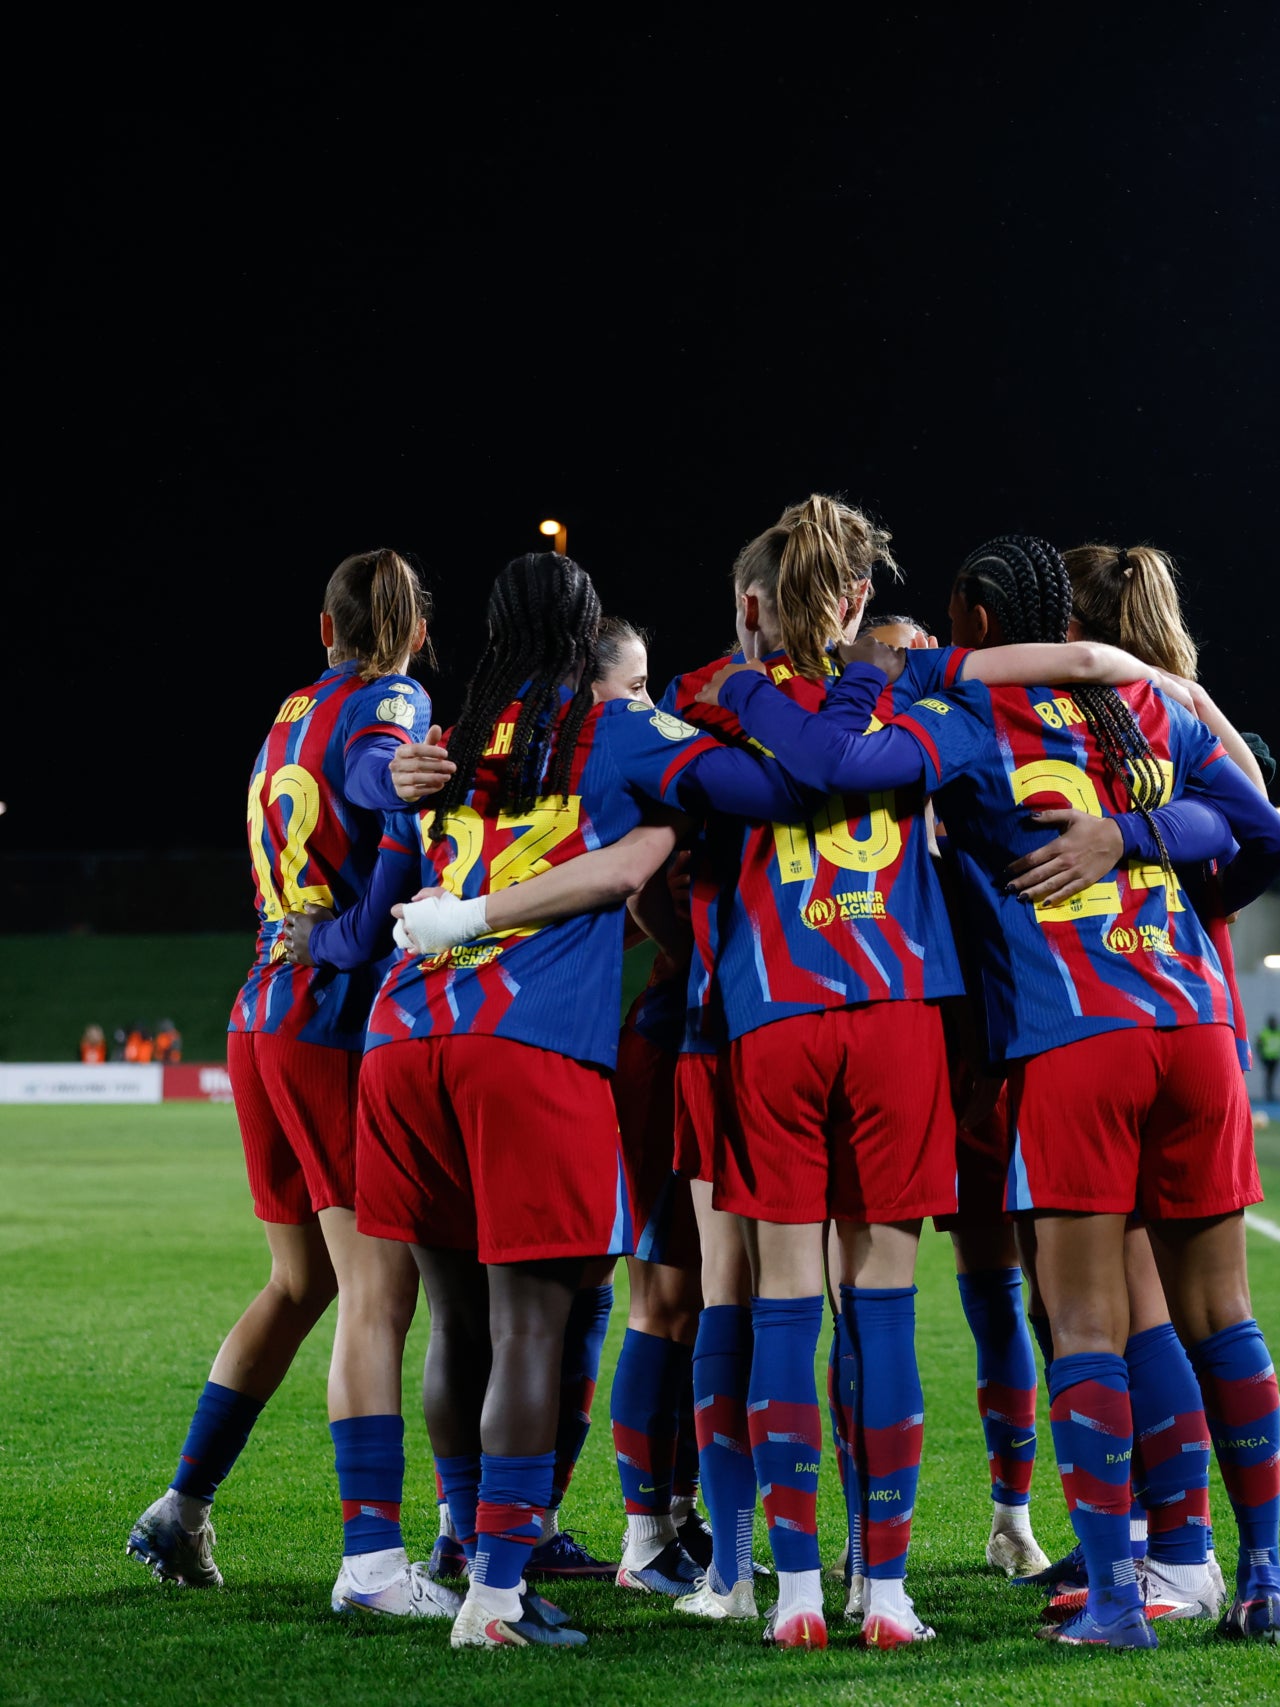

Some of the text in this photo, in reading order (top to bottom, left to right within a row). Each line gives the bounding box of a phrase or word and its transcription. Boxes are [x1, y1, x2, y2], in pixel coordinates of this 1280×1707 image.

[247, 764, 334, 922] 12
[836, 890, 884, 905] UNHCR
[839, 902, 886, 917] ACNUR
[451, 945, 504, 957] UNHCR
[795, 1462, 819, 1474] BARÇ
[868, 1489, 901, 1502] ARÇA
